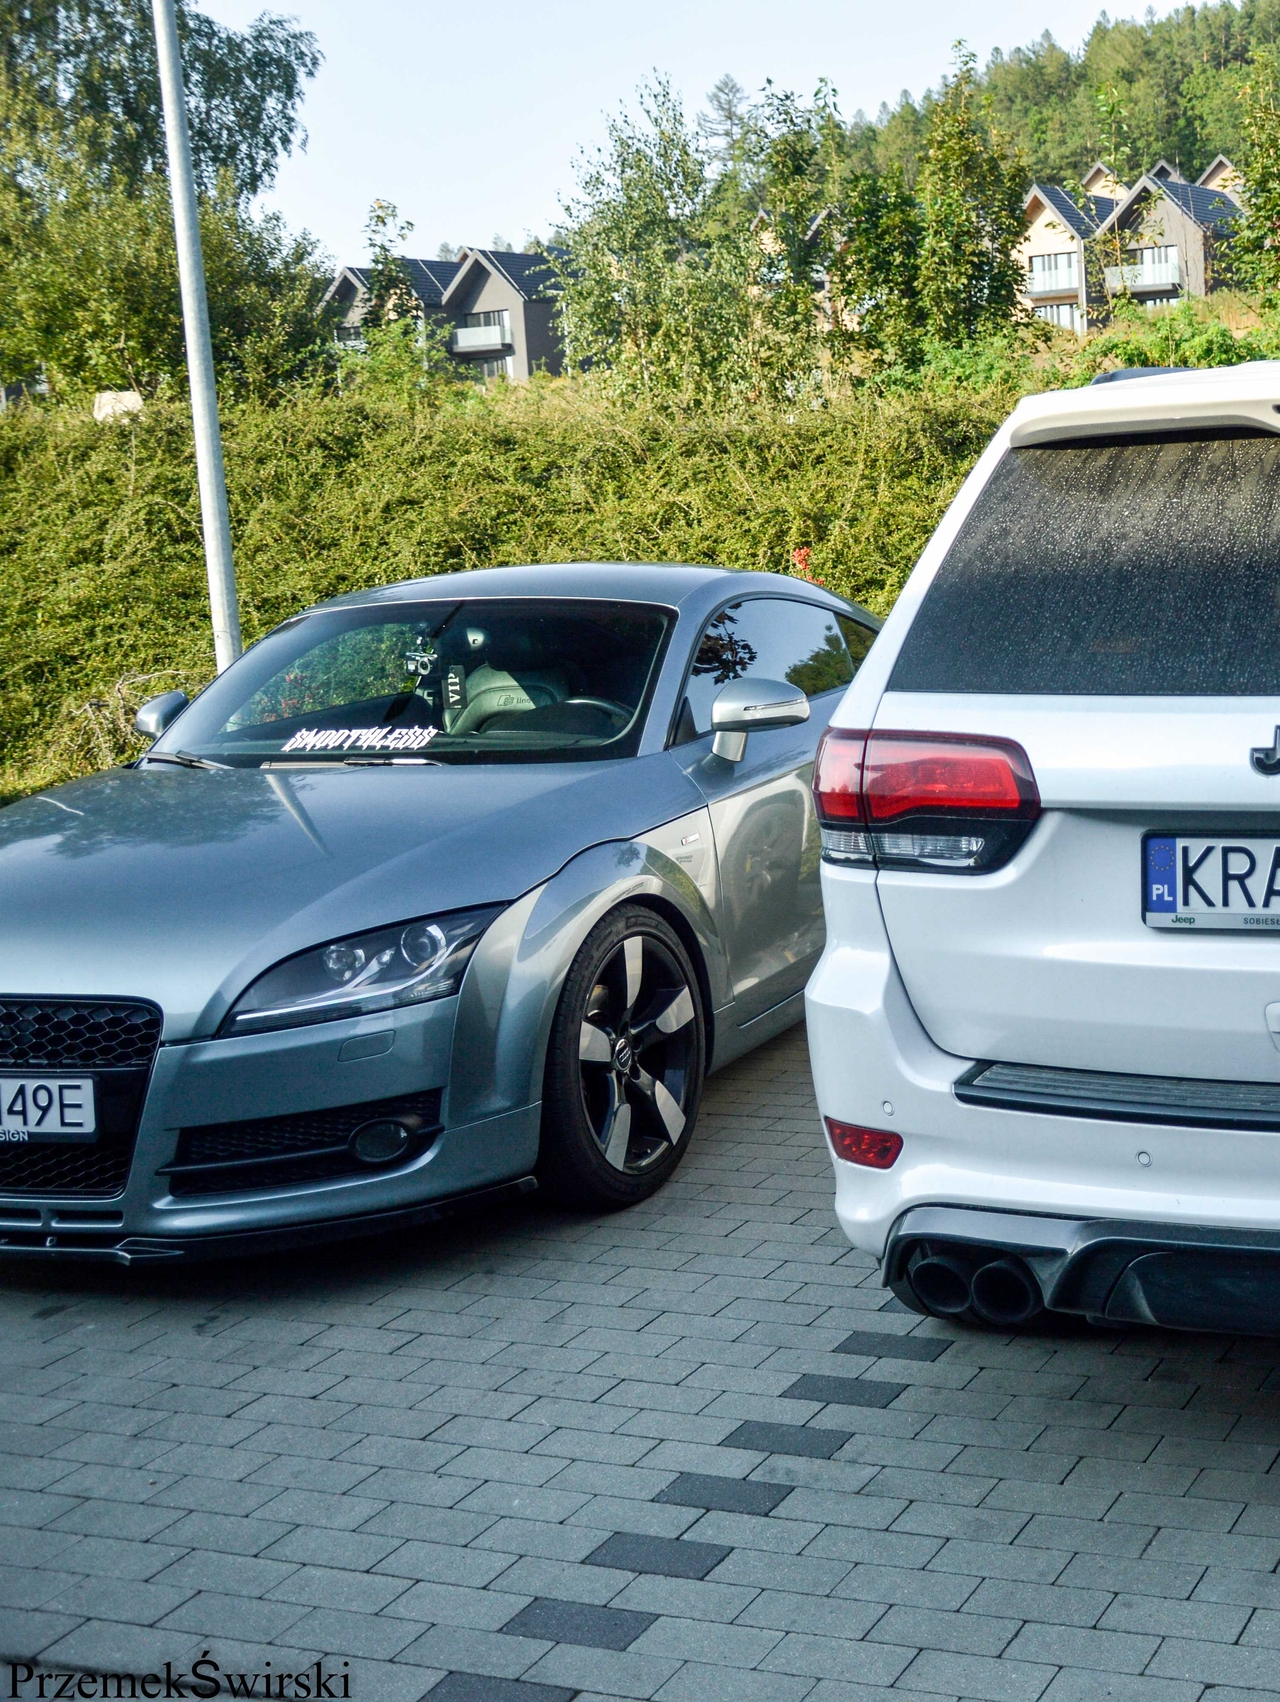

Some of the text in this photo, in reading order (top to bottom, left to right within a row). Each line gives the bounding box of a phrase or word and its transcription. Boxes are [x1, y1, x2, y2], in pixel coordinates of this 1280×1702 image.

[447, 672, 461, 704] VIP
[280, 725, 439, 752] SMOOTHLESS
[1152, 884, 1174, 901] PL
[1171, 914, 1196, 925] Jeep
[0, 1083, 84, 1127] 49E
